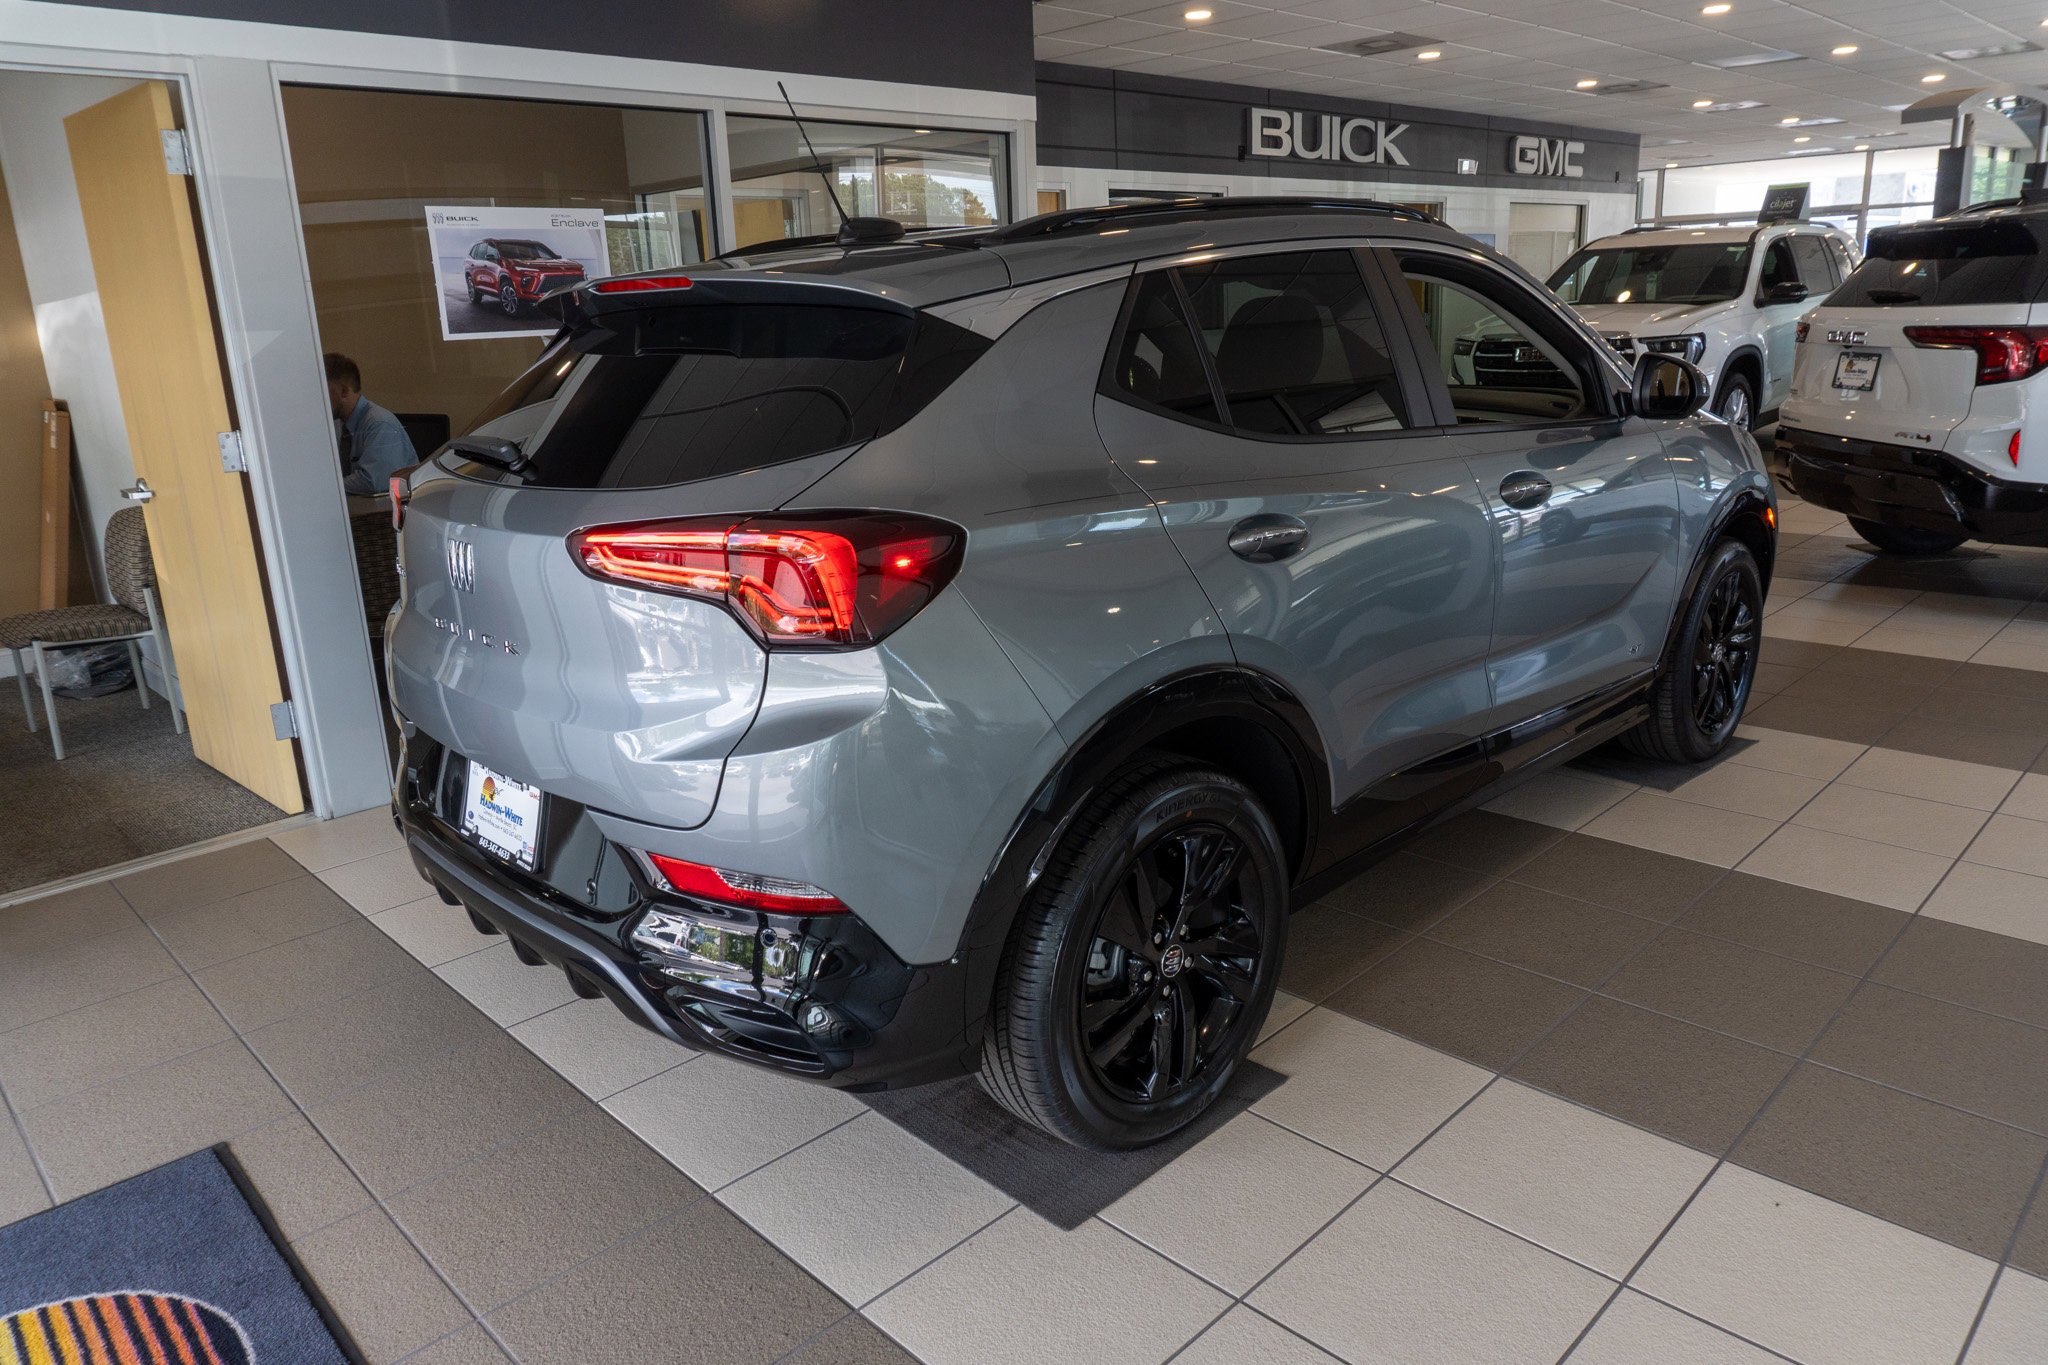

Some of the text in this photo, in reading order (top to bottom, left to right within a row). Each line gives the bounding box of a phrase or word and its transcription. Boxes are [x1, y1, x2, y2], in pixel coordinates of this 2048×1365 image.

[1251, 107, 1410, 166] BUICK
[1514, 136, 1585, 178] GMC
[551, 218, 599, 227] Enclave
[1827, 331, 1868, 344] GMC
[434, 617, 521, 656] BUICK
[479, 837, 510, 860] 843-347-4633
